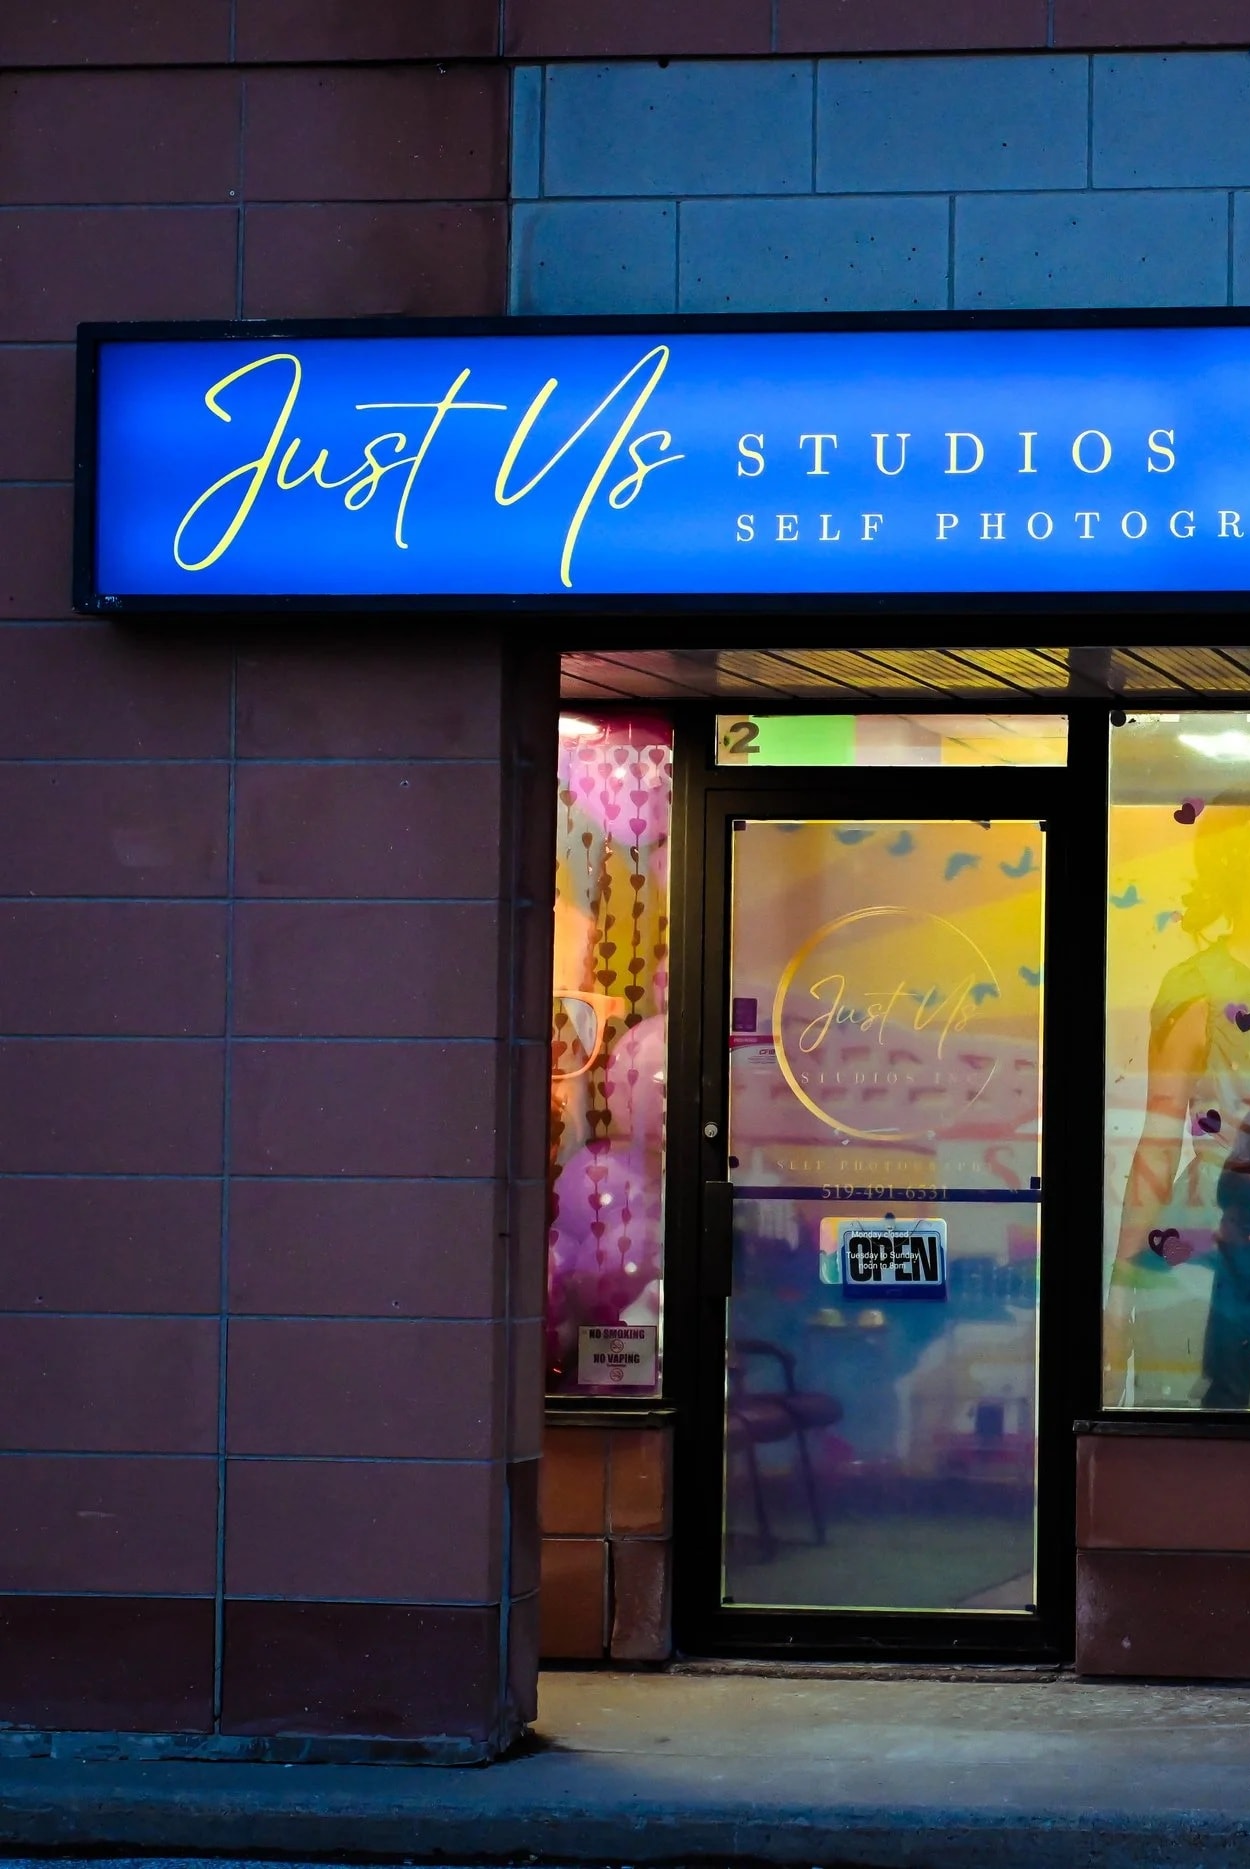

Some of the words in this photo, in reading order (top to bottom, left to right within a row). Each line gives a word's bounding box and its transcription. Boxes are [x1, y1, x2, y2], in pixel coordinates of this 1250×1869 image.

[737, 428, 1176, 477] STUDIOS
[173, 353, 507, 571] Just
[495, 345, 685, 587] Us
[736, 513, 884, 542] SELF
[729, 721, 761, 754] 2
[799, 974, 918, 1053] Just
[913, 973, 985, 1060] Us
[800, 1071, 915, 1084] STUDIOS
[840, 1160, 993, 1172] PHOTORPH
[821, 1183, 949, 1200] 519-491-6531
[851, 1230, 881, 1239] Monday
[883, 1230, 909, 1238] closed
[846, 1251, 879, 1260] Tuesday
[880, 1251, 888, 1259] to
[890, 1251, 920, 1260] Sunday
[848, 1236, 939, 1282] OPEN
[880, 1262, 888, 1270] to
[588, 1328, 601, 1339] NO
[603, 1328, 645, 1339] SMOKING
[593, 1353, 606, 1364] NO
[607, 1353, 641, 1364] VAPING
